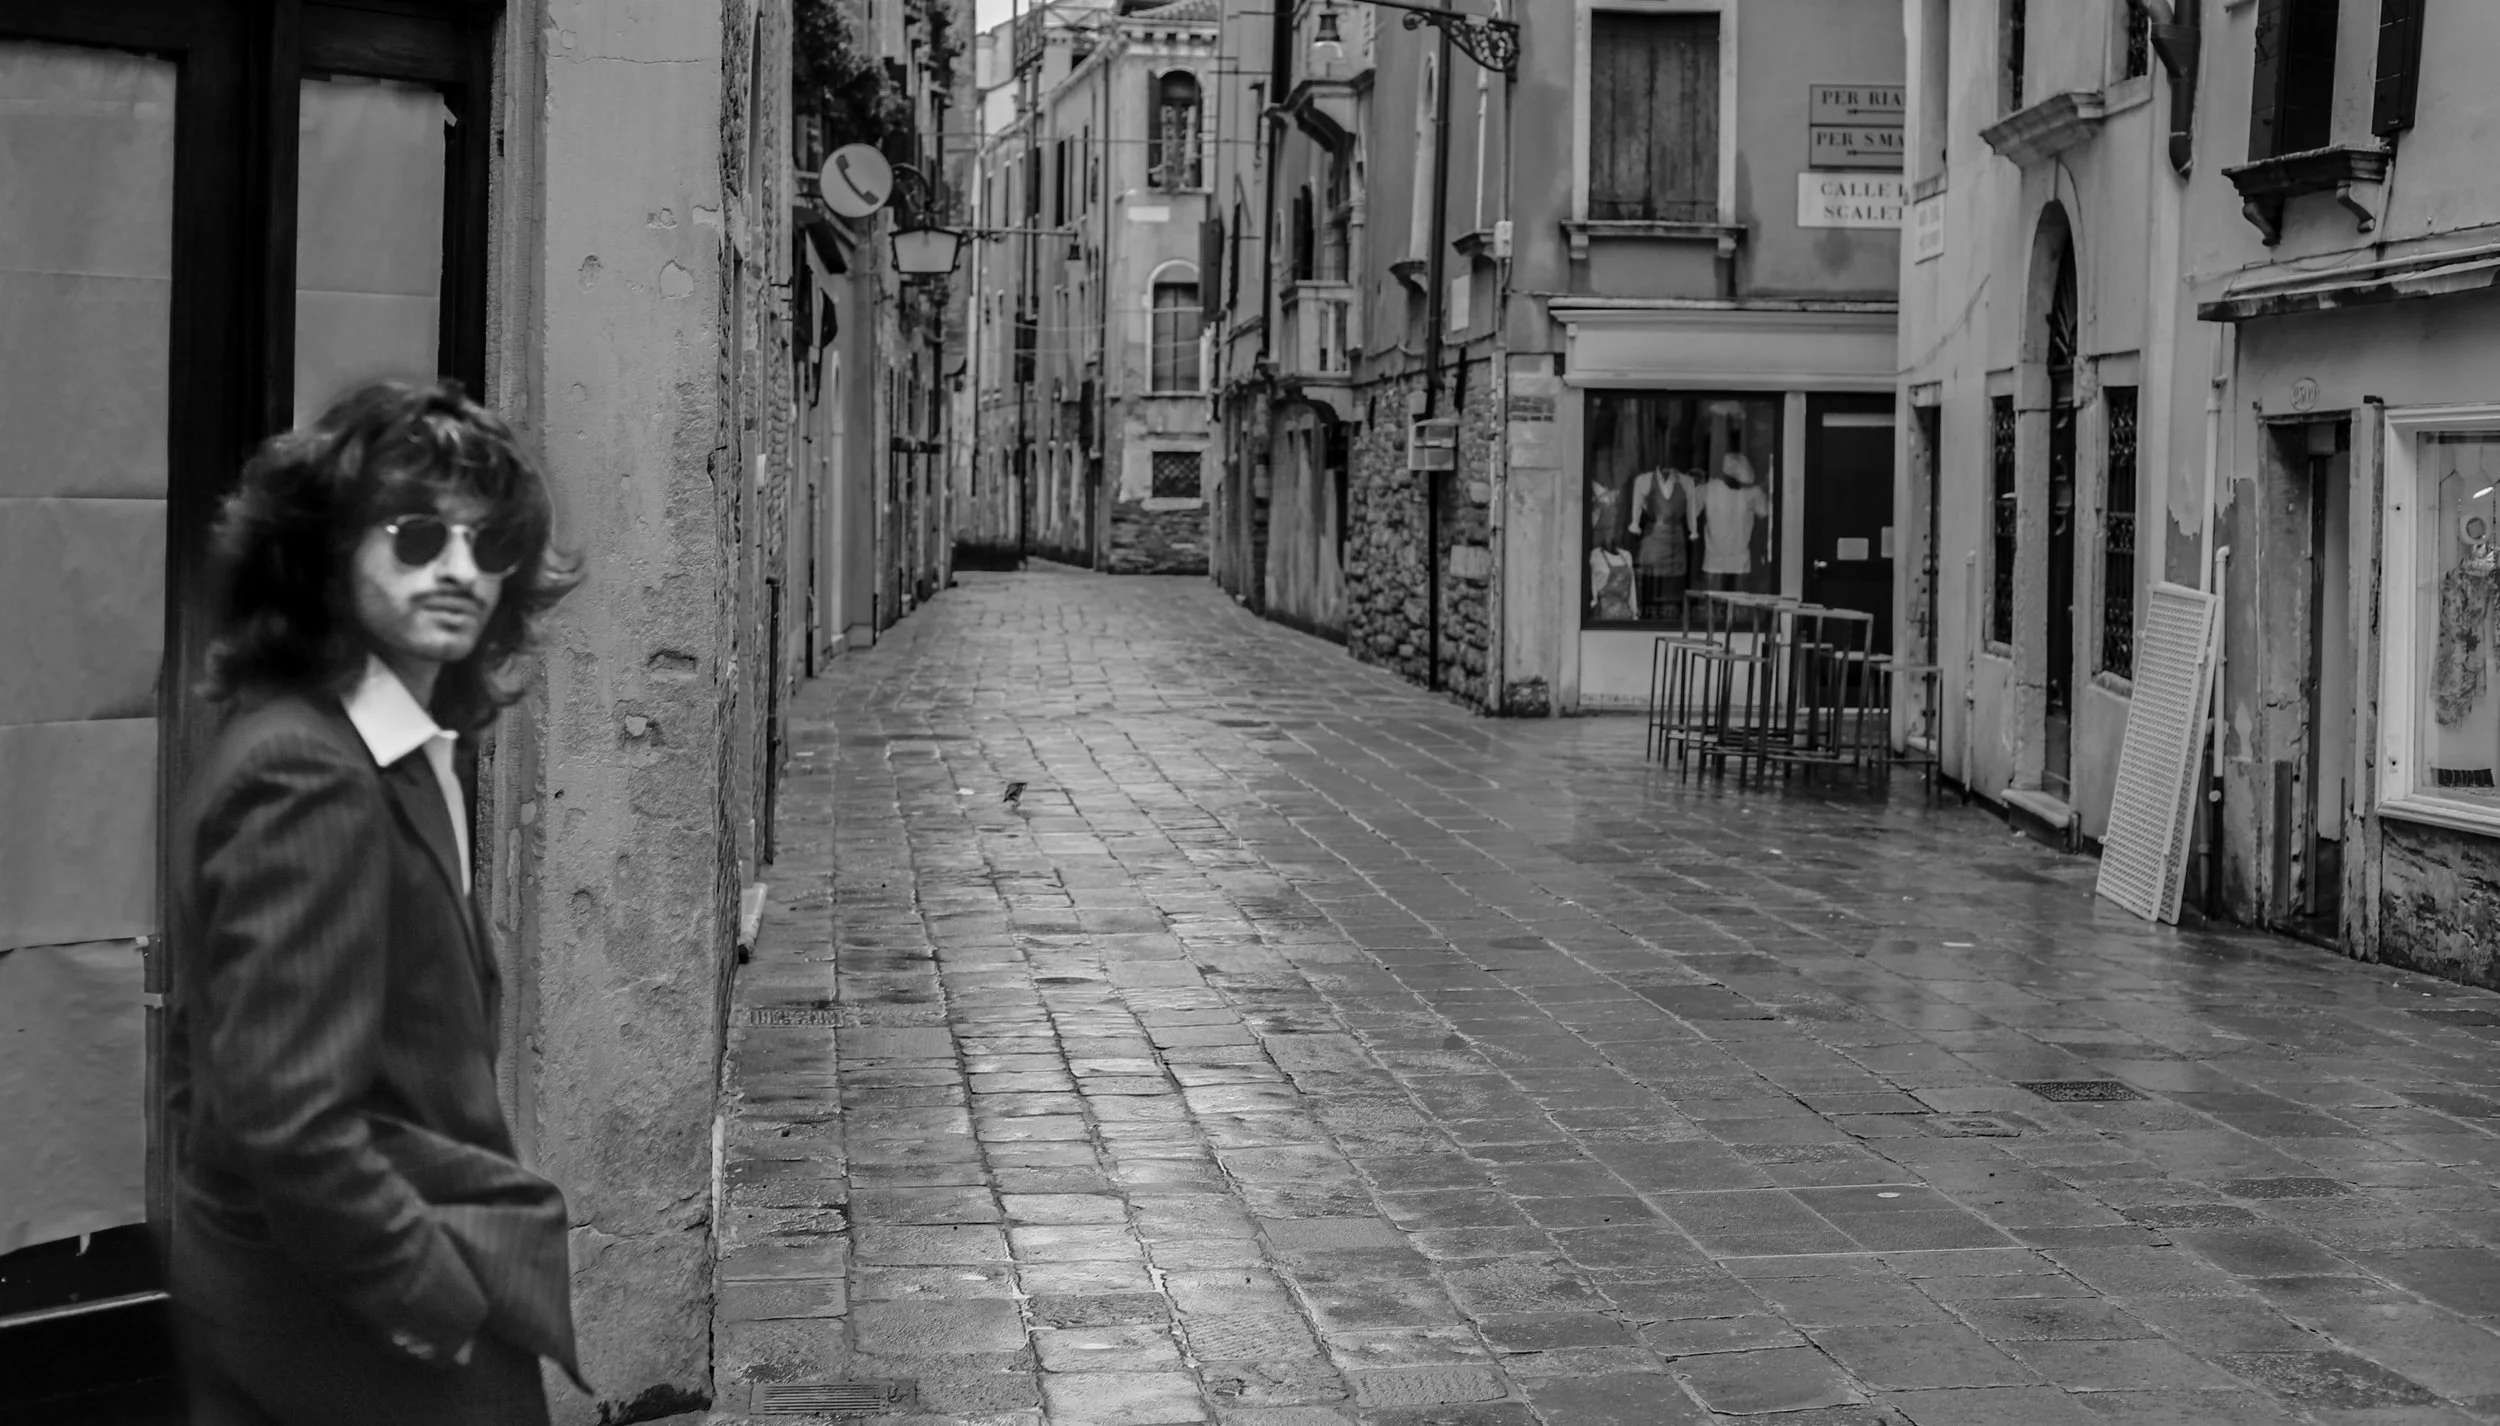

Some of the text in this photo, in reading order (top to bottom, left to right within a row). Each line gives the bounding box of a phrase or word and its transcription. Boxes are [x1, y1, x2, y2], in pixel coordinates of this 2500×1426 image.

[1821, 90, 1902, 106] PER RIA
[1816, 131, 1853, 146] PER
[1820, 182, 1891, 198] CALLE
